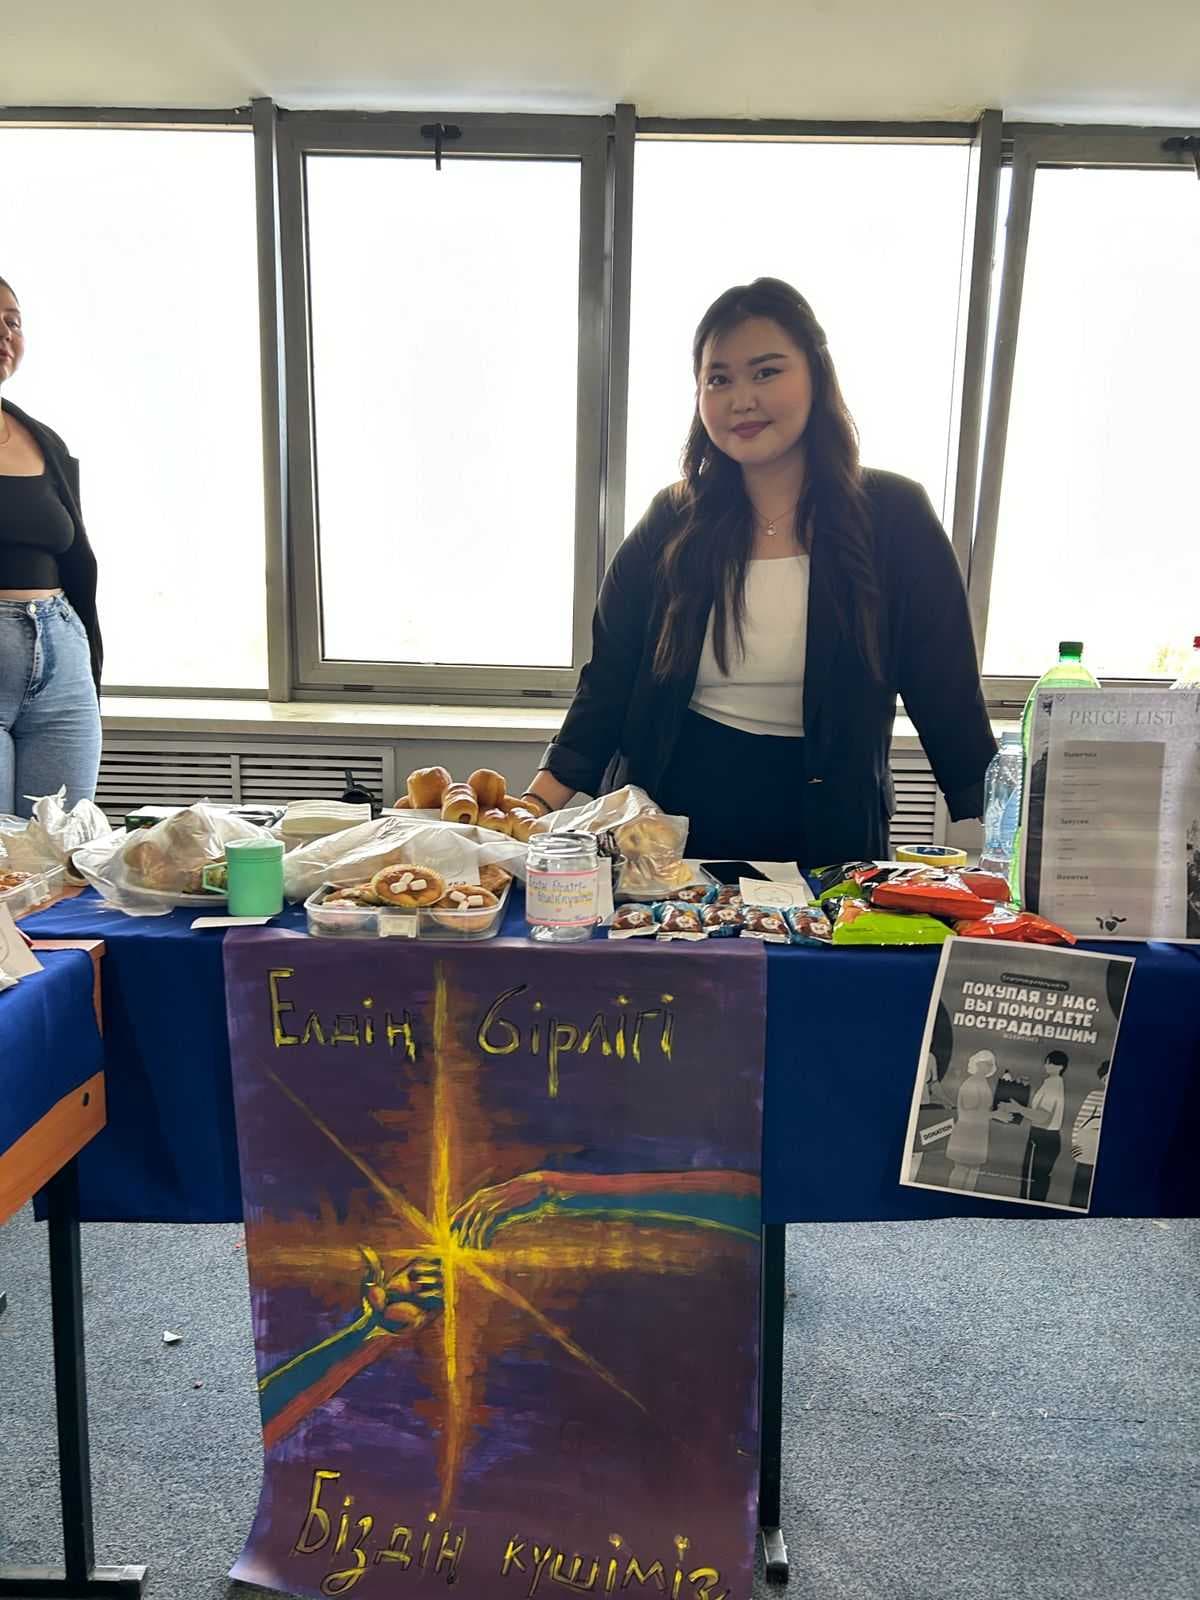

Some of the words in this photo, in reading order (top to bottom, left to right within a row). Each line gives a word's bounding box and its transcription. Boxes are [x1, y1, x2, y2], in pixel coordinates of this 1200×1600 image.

[1069, 709, 1128, 726] PRICE
[1135, 709, 1176, 726] LIST
[962, 981, 1041, 1005] ПОКУПАЯ
[1046, 993, 1059, 1007] У
[953, 1012, 1098, 1045] ПОСТРАДАВШИМ
[964, 998, 991, 1013] ВЫ
[997, 1001, 1094, 1028] ПОМОГАЕТЕ
[267, 967, 416, 1063] Елдің
[477, 983, 675, 1099] бірлігі
[292, 1468, 467, 1597] Біздің
